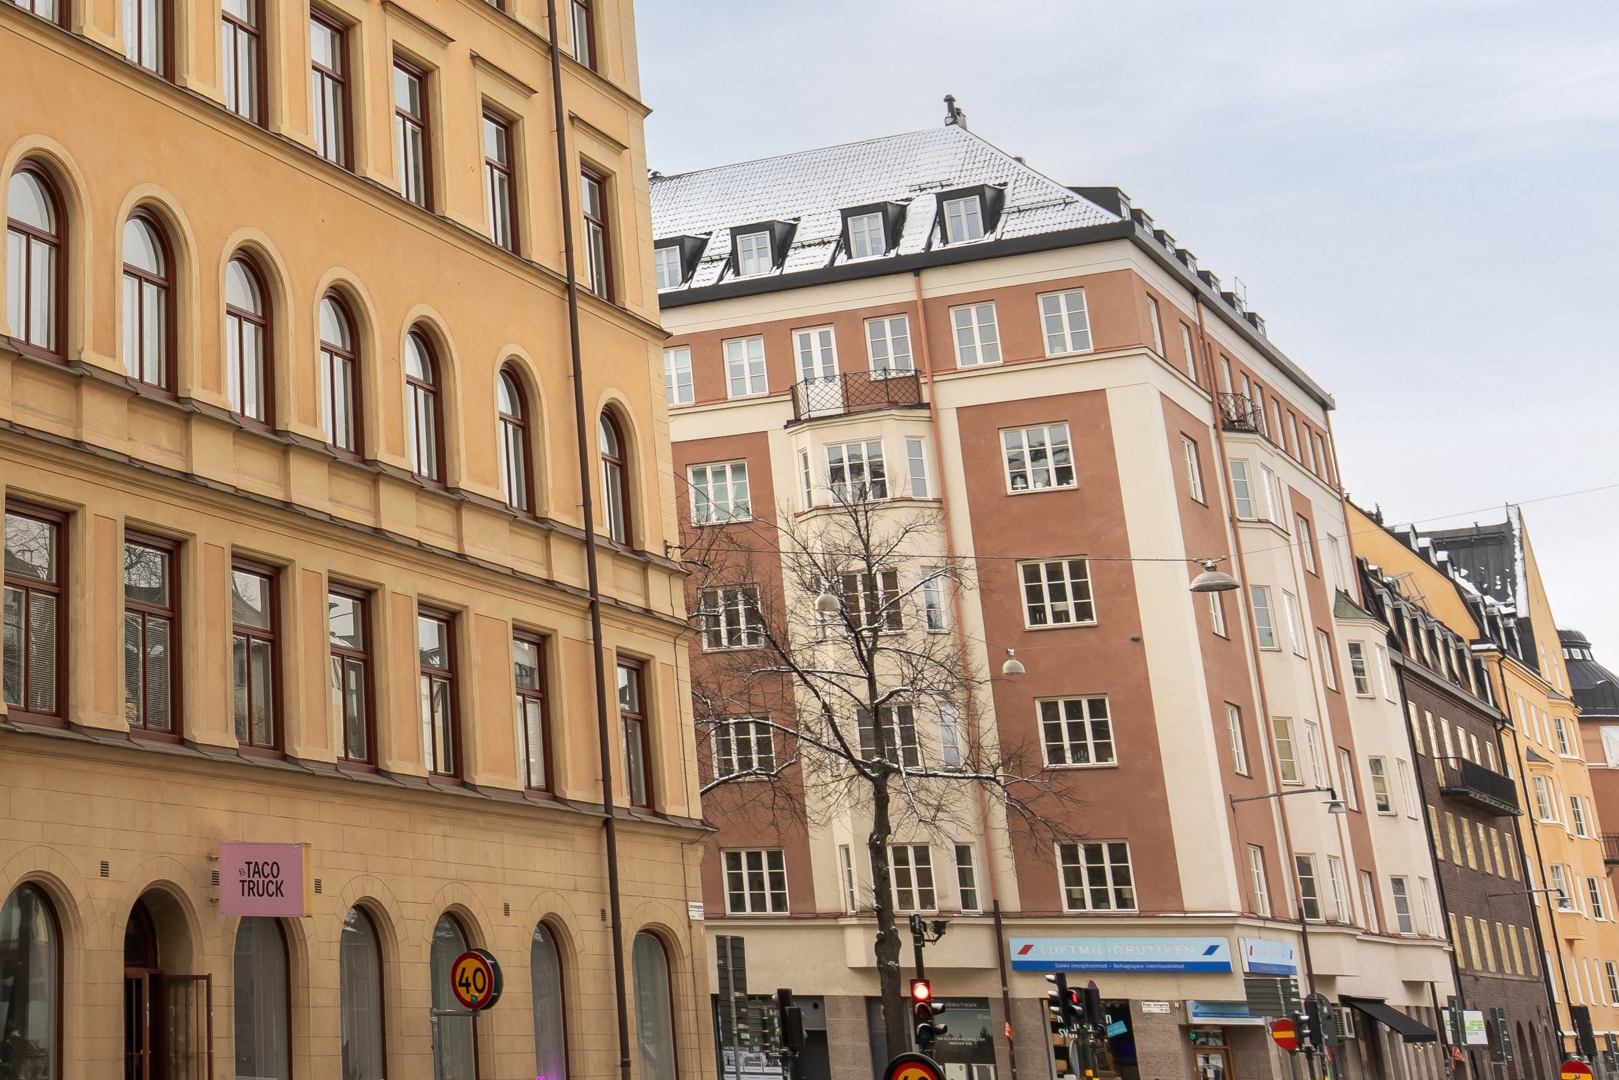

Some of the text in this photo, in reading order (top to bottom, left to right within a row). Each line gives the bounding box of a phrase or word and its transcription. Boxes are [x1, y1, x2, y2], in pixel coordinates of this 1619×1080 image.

[239, 868, 246, 877] EL
[245, 861, 280, 879] TACO
[239, 880, 284, 897] TRUCK
[458, 967, 487, 994] 40
